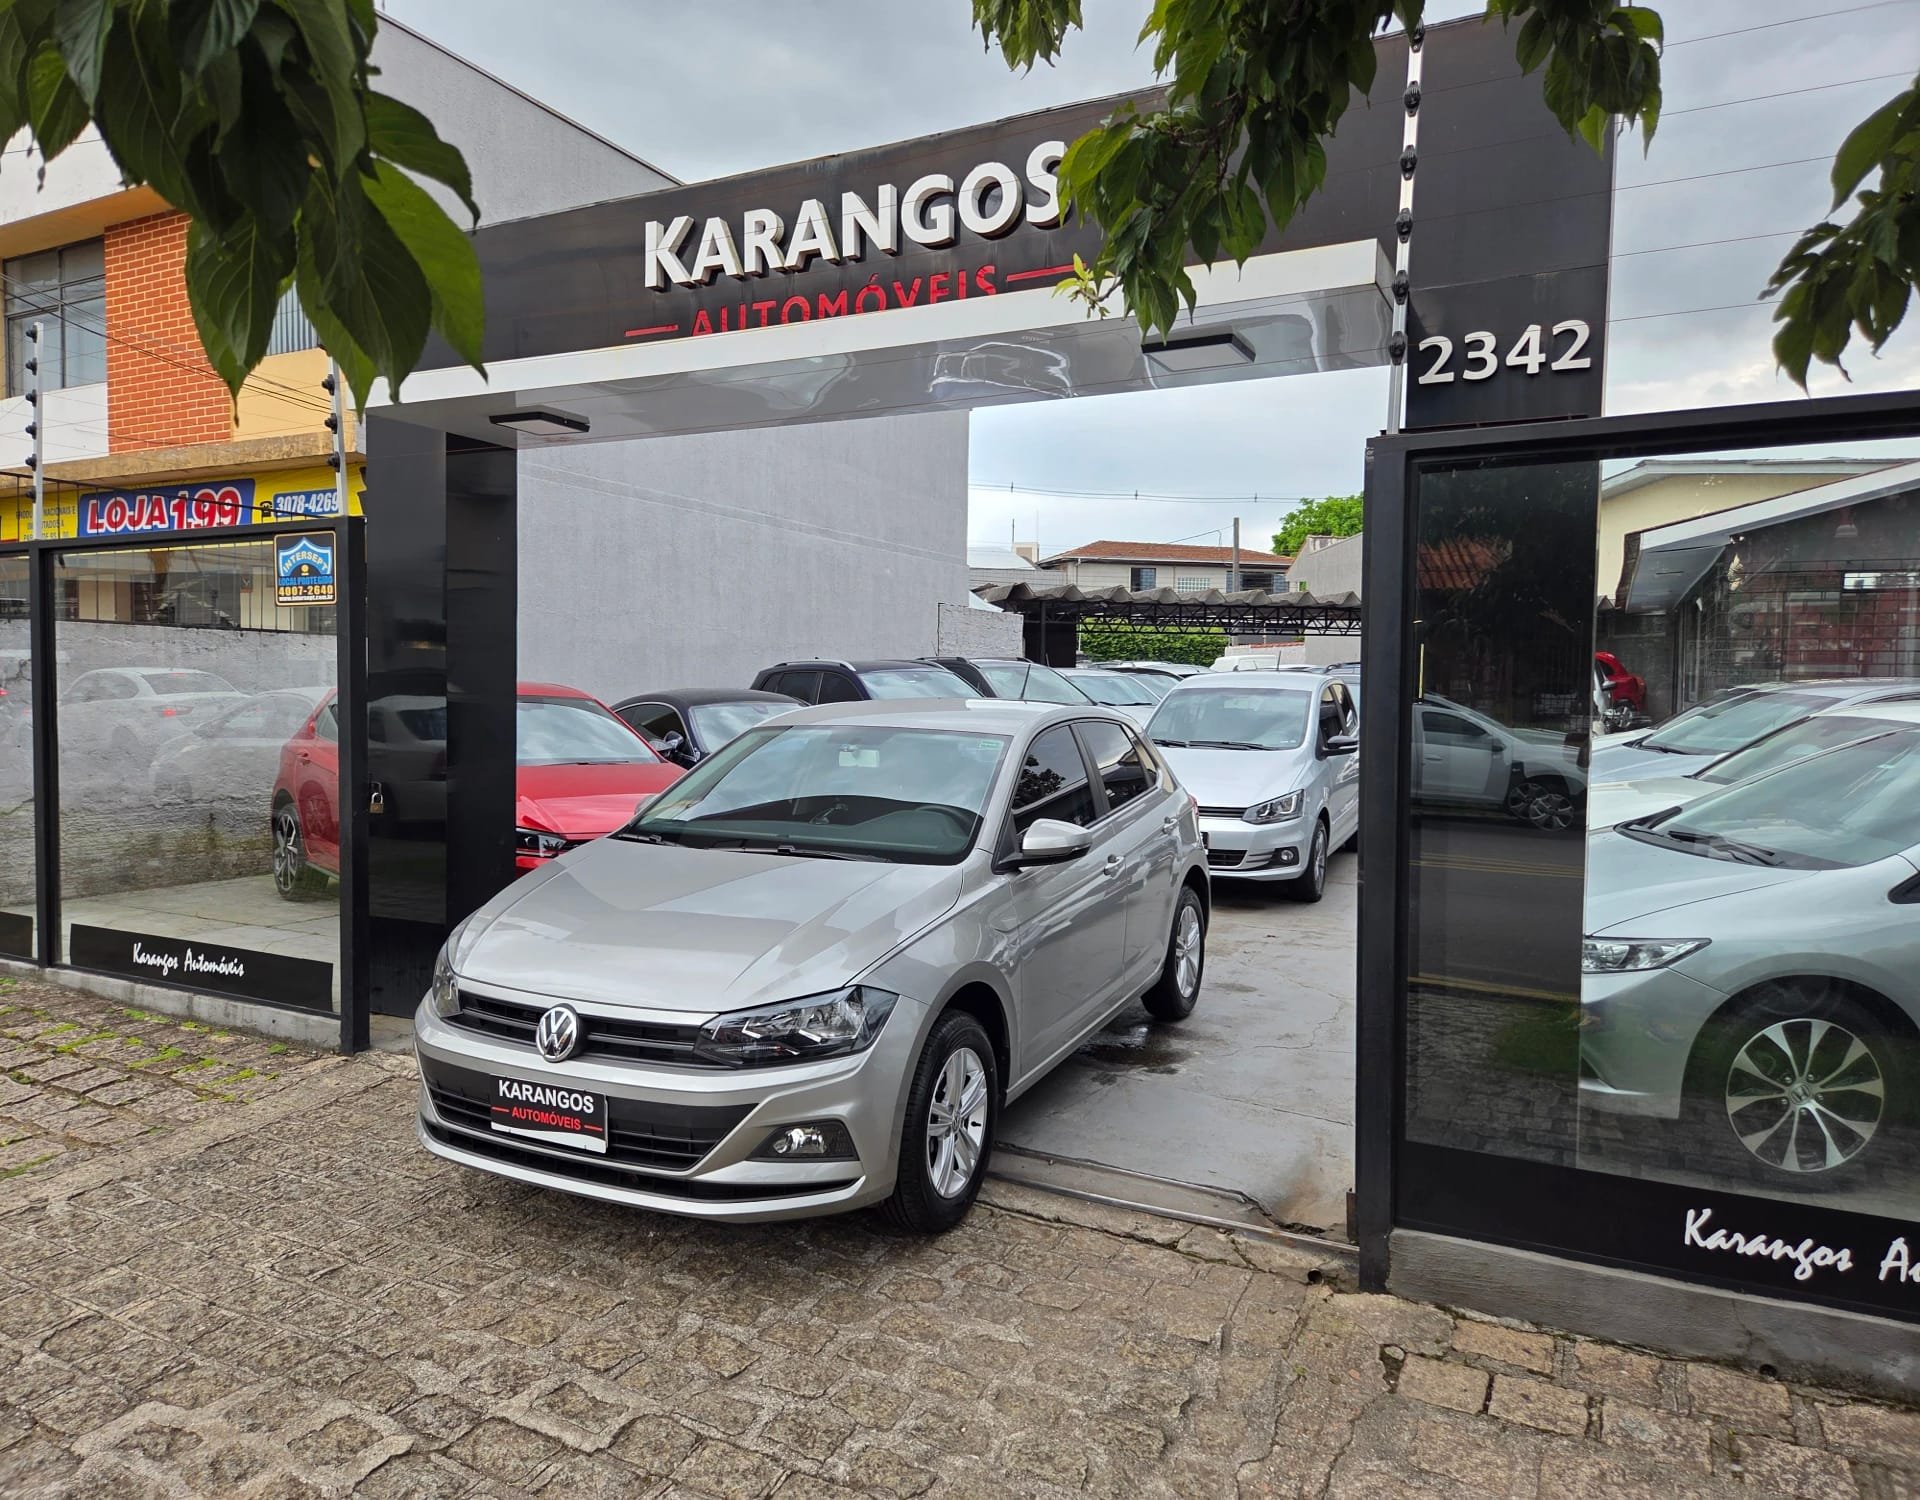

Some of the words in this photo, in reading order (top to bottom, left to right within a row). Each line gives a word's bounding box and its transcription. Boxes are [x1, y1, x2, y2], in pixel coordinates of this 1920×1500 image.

[644, 141, 1069, 291] KARANGOS
[1418, 319, 1592, 384] 2342
[87, 494, 169, 534] LOJA
[282, 551, 329, 573] INTERSEPT
[279, 577, 297, 586] LOCAL
[279, 585, 334, 596] 4007-2640
[132, 942, 178, 976] Karangos
[498, 1079, 595, 1114] KARANGOS
[512, 1106, 582, 1131] AUTOMÓVEIS
[1684, 1208, 1854, 1281] Karangos
